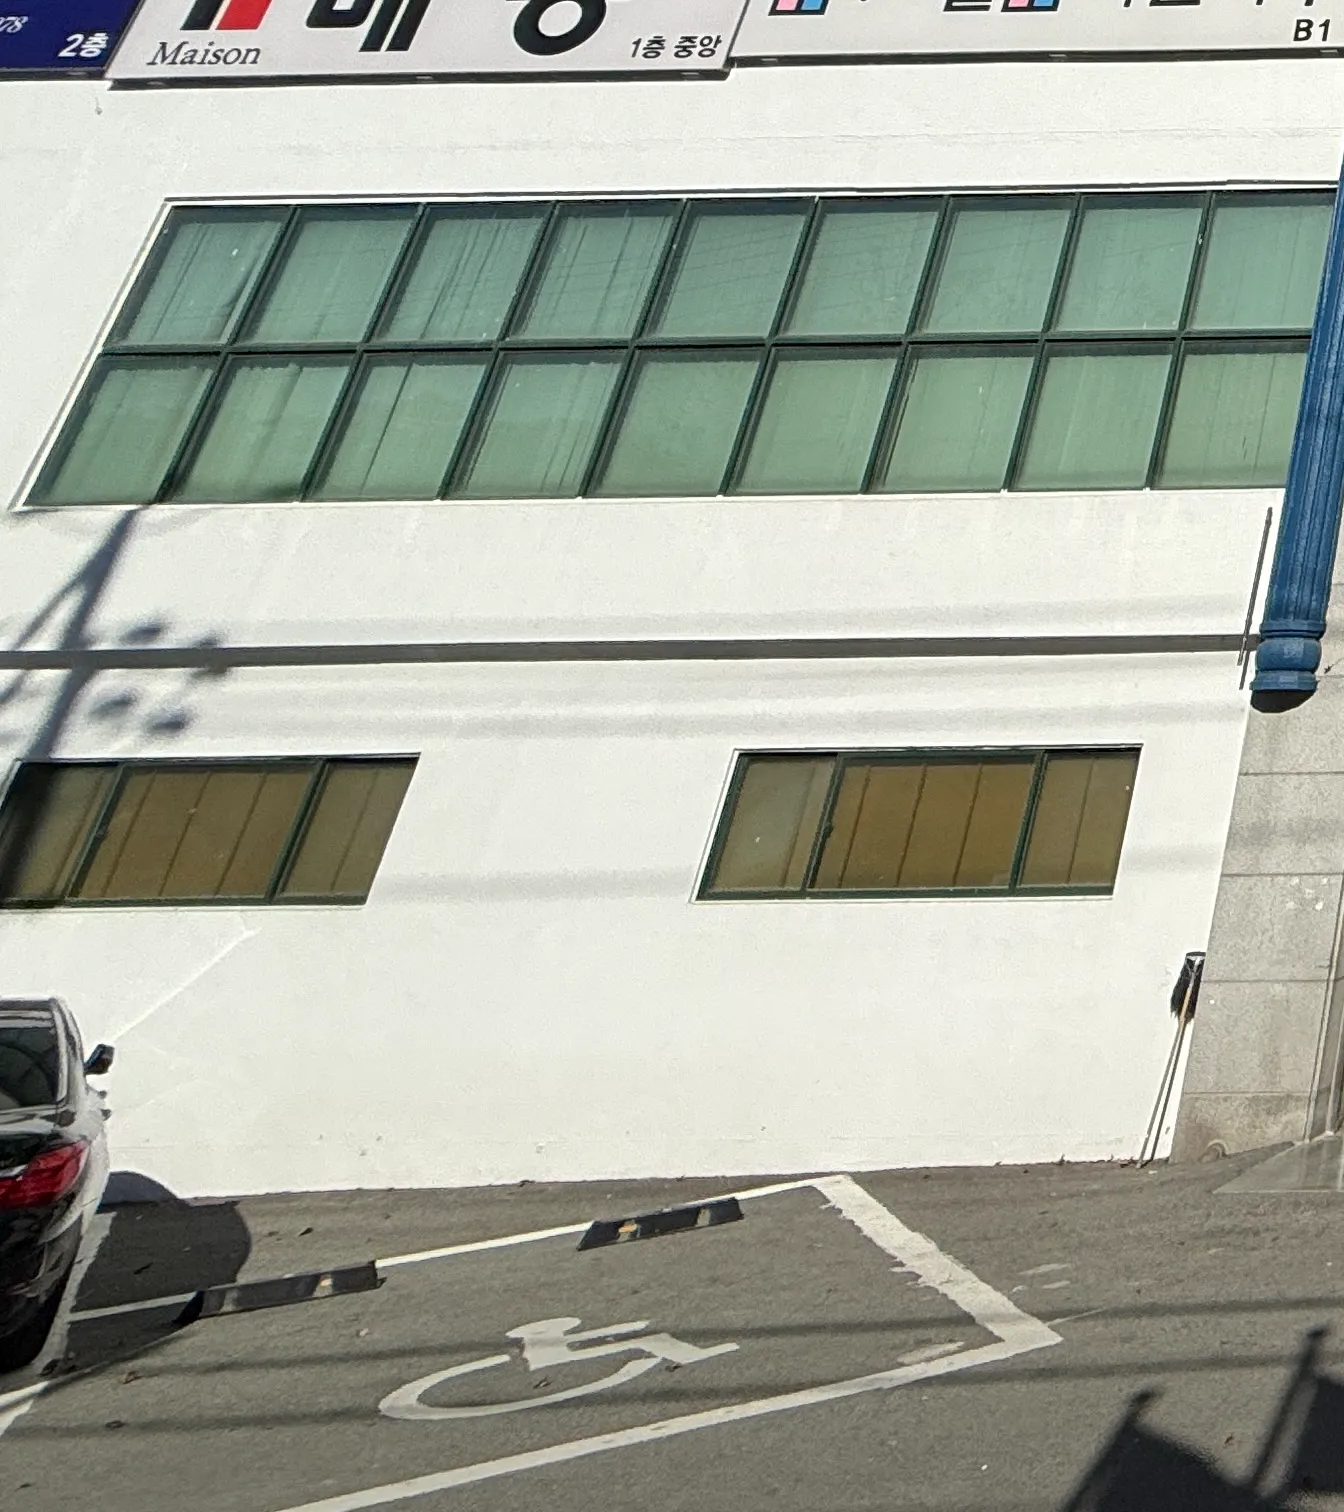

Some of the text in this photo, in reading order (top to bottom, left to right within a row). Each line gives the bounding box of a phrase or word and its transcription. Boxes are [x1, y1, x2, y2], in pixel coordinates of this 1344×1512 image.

[1293, 18, 1332, 43] B1
[57, 32, 109, 58] 2층
[146, 41, 261, 67] Maison
[631, 34, 722, 59] 1층 중앙
